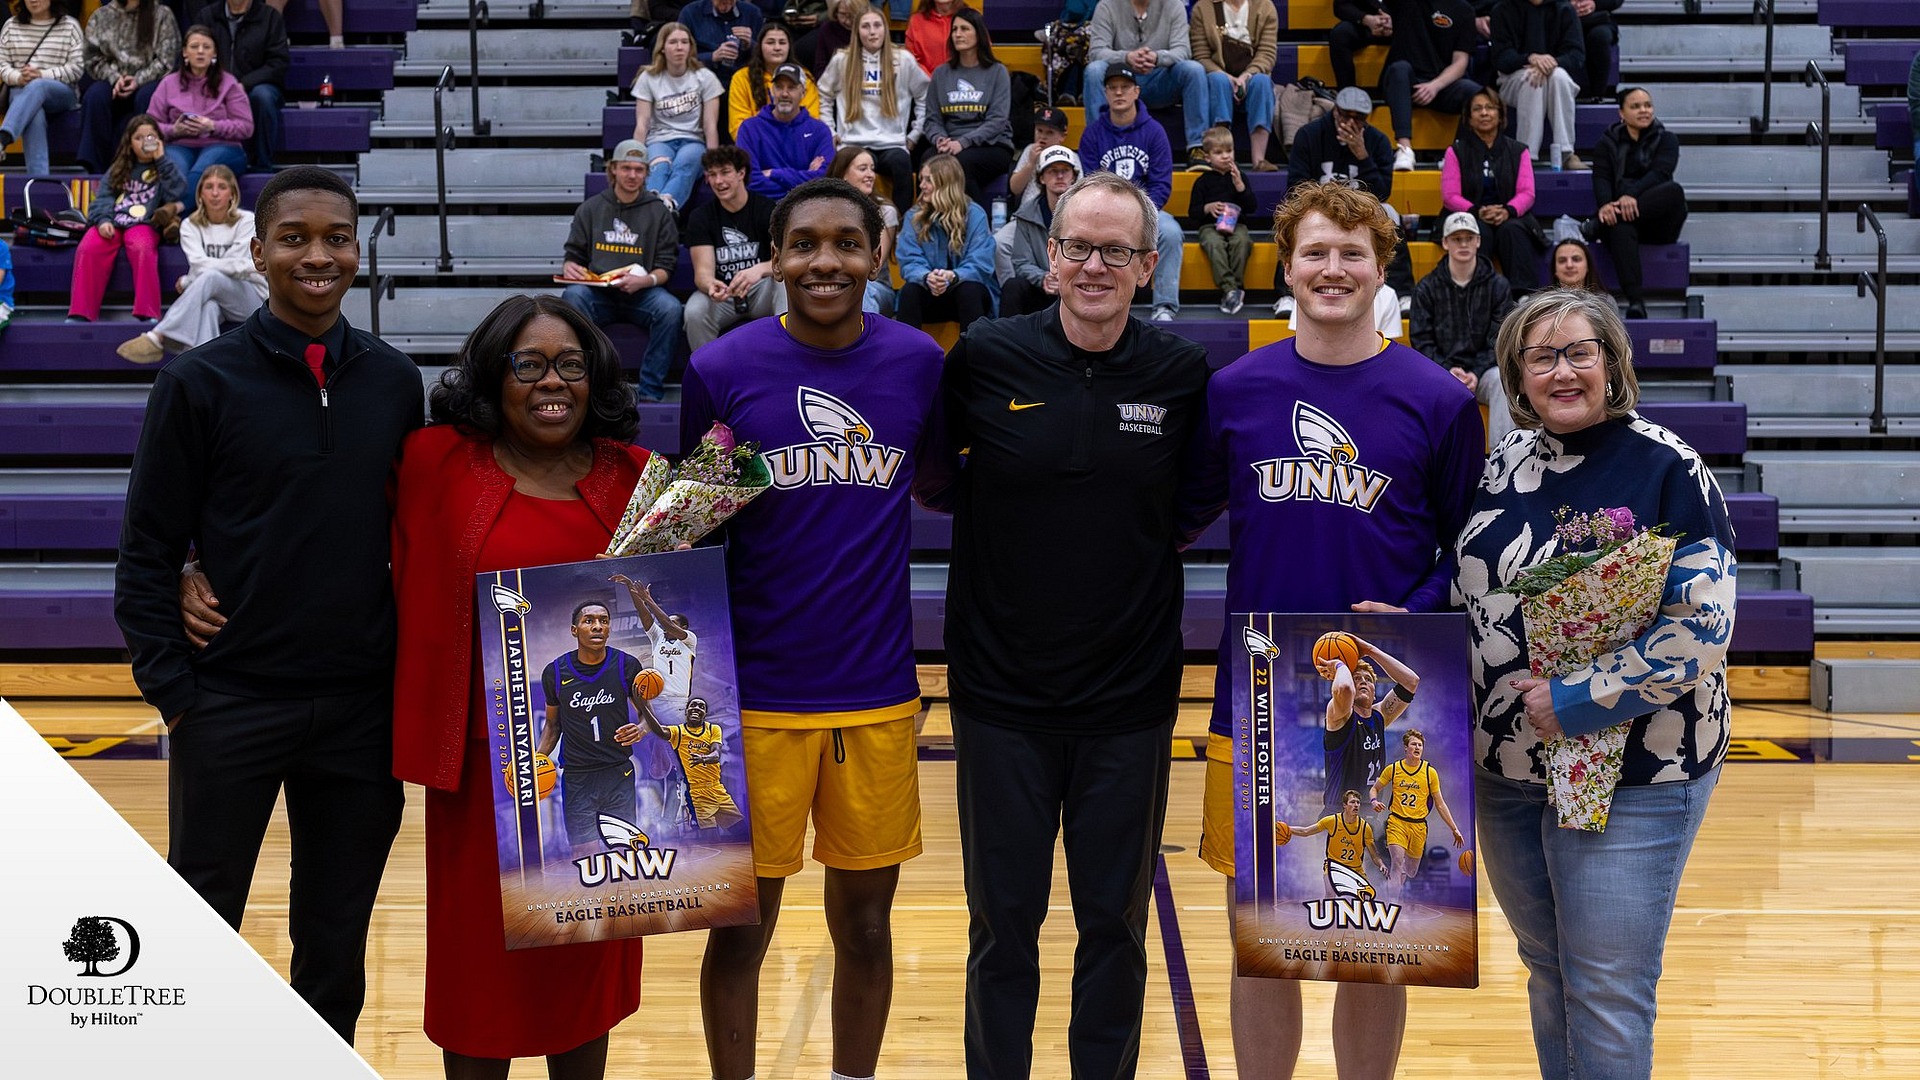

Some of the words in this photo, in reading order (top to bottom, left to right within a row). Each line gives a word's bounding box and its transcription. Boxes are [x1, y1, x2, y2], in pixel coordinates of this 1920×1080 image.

[946, 90, 985, 103] UNW
[595, 242, 643, 254] BASKETBALL
[603, 230, 639, 245] UNW
[716, 242, 760, 263] UNW
[1117, 403, 1168, 425] UNW
[1119, 422, 1163, 435] BASKETBALL
[761, 441, 906, 490] UNW
[1250, 456, 1393, 514] UNW
[659, 645, 682, 658] Eagles
[508, 639, 526, 717] JAPHETH
[667, 660, 675, 675] 1
[1256, 668, 1268, 686] 22
[494, 678, 504, 716] CLASS
[569, 688, 615, 712] Eagles
[1256, 691, 1269, 735] WILL
[497, 723, 506, 738] OF
[590, 716, 600, 742] 1
[1240, 717, 1249, 755] CLASS
[515, 722, 534, 807] NYAMARI
[1241, 761, 1249, 776] OF
[1257, 741, 1270, 806] FOSTER
[1399, 780, 1421, 791] Eagles
[1400, 793, 1417, 808] 22
[1340, 848, 1355, 861] 22
[572, 848, 678, 888] UNW
[527, 897, 602, 911] UNIVERSITY
[610, 894, 624, 902] OF
[632, 882, 731, 900] NORTHWESTERN
[555, 907, 603, 924] EAGLE
[607, 896, 703, 917] BASKETBALL
[1302, 898, 1402, 934] UNW
[1258, 937, 1329, 947] UNIVERSITY
[1355, 941, 1450, 952] NORTHWESTERN
[1284, 948, 1328, 962] EAGLE
[1332, 950, 1423, 966] BASKETBALL
